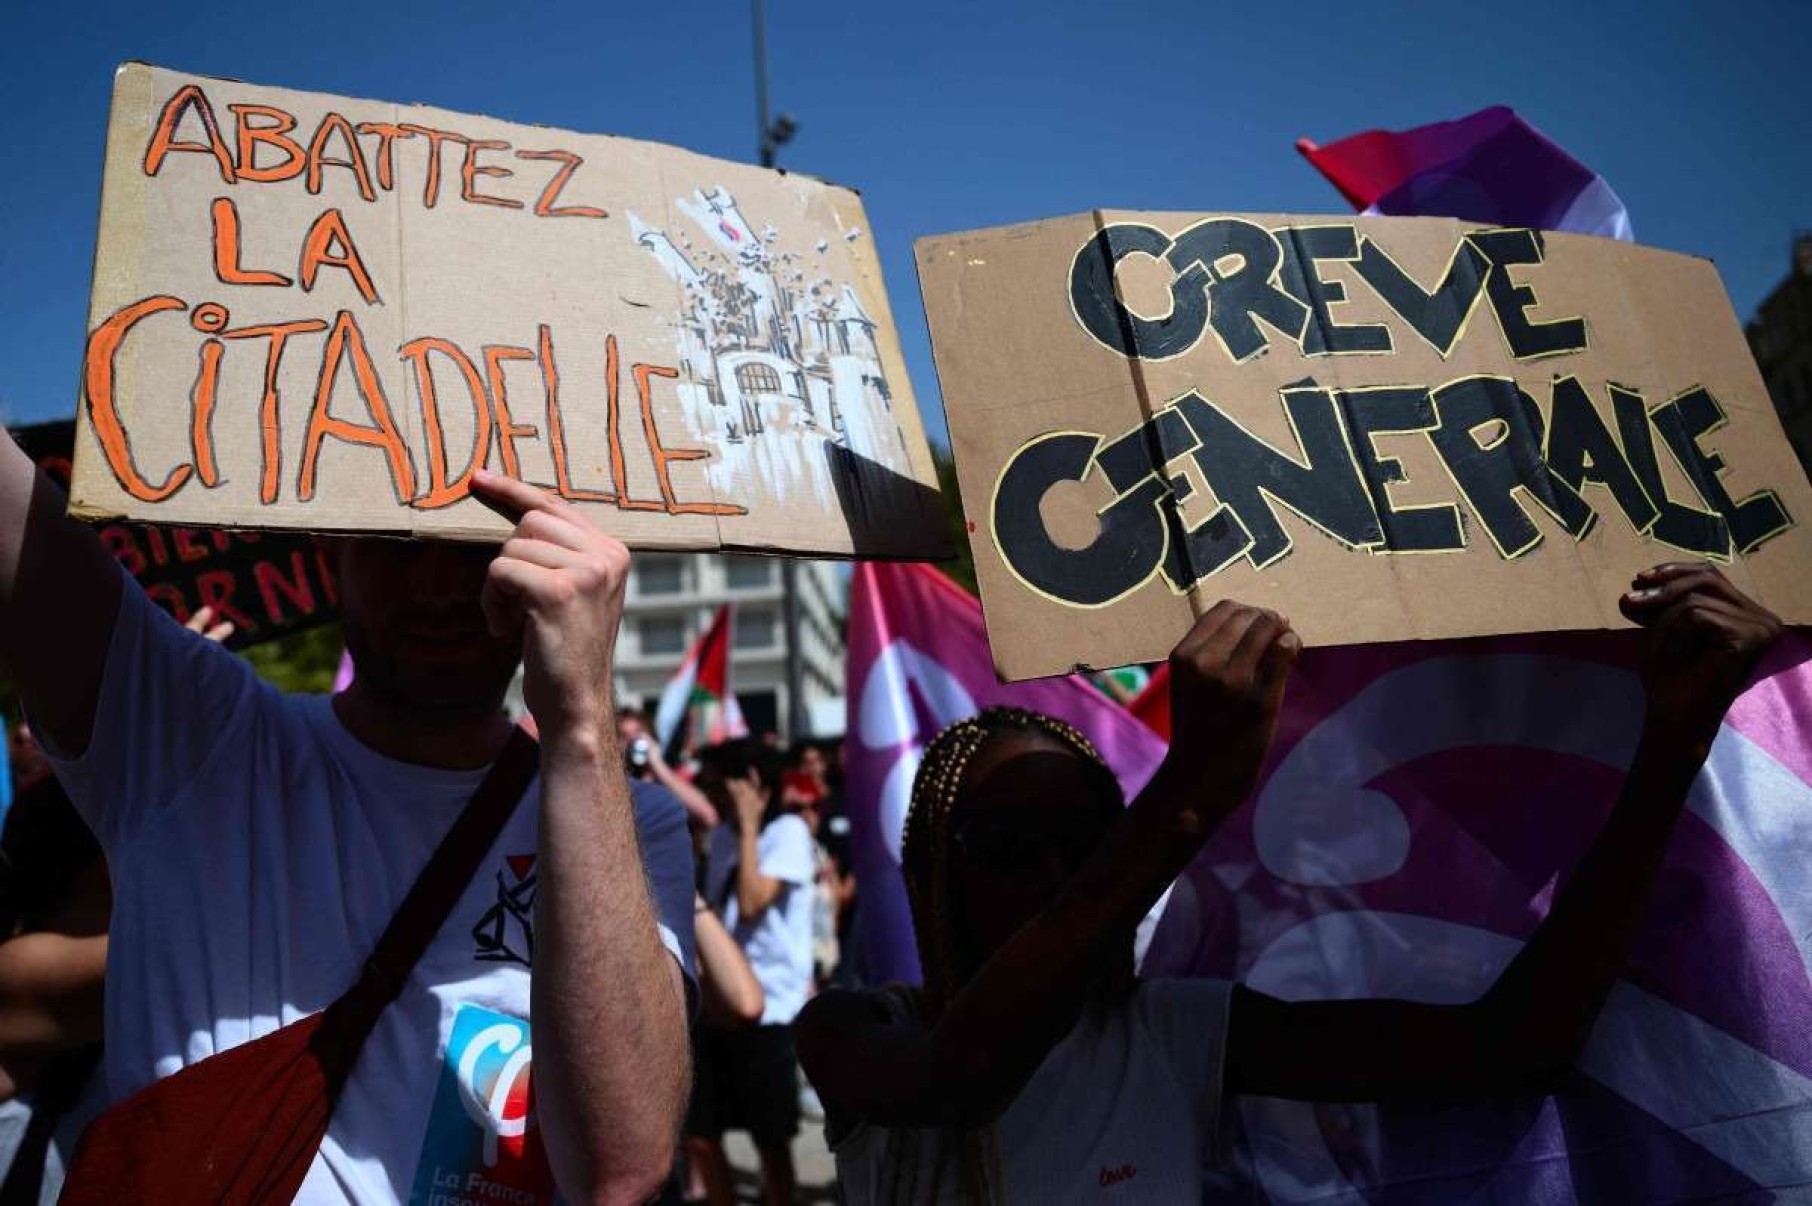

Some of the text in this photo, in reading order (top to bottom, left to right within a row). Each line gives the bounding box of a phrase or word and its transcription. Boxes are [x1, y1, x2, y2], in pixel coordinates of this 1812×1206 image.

[144, 85, 607, 217] ABATTEZ
[212, 197, 382, 304] LA
[1069, 218, 1589, 361] GREVE
[991, 375, 1794, 607] GENERALE
[433, 1165, 536, 1205] La France
